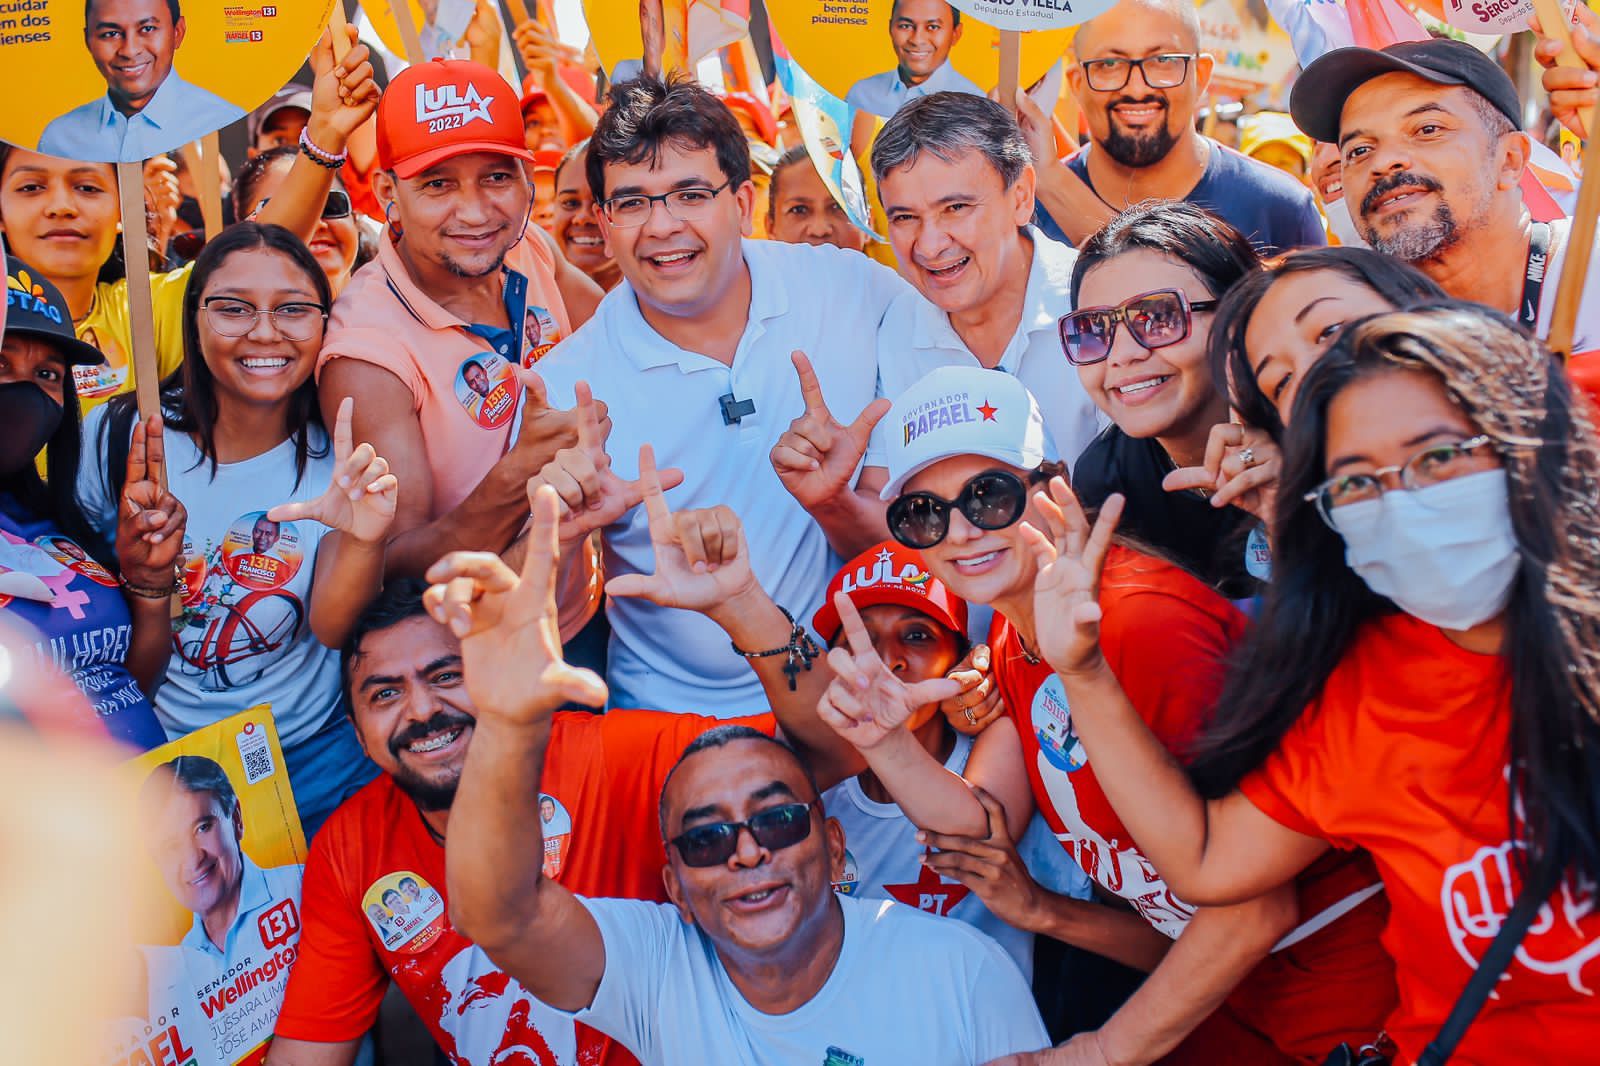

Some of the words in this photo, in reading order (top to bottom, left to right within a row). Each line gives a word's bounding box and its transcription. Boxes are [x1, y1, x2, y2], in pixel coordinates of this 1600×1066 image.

[21, 14, 50, 27] dos
[262, 6, 276, 17] 131
[812, 14, 868, 25] piauienses
[824, 3, 848, 13] bem
[849, 5, 869, 14] dos
[974, 3, 1014, 16] Deputado
[1016, 9, 1054, 19] Estadual
[251, 31, 262, 41] 13
[415, 82, 495, 124] LULA
[429, 114, 461, 134] 2022
[1527, 252, 1547, 283] NIKE
[485, 384, 507, 408] 1313
[487, 393, 511, 420] FRANCISCO
[902, 392, 969, 424] GOVERNADOR
[903, 403, 977, 447] RAFAEL
[239, 565, 276, 578] FRANCISCO
[250, 555, 278, 571] 1313
[842, 559, 926, 594] LULA
[1043, 696, 1066, 724] 15110
[920, 893, 948, 916] PT
[260, 903, 297, 943] 131
[196, 956, 252, 999] SENADOR
[210, 997, 263, 1041] JUSSARA
